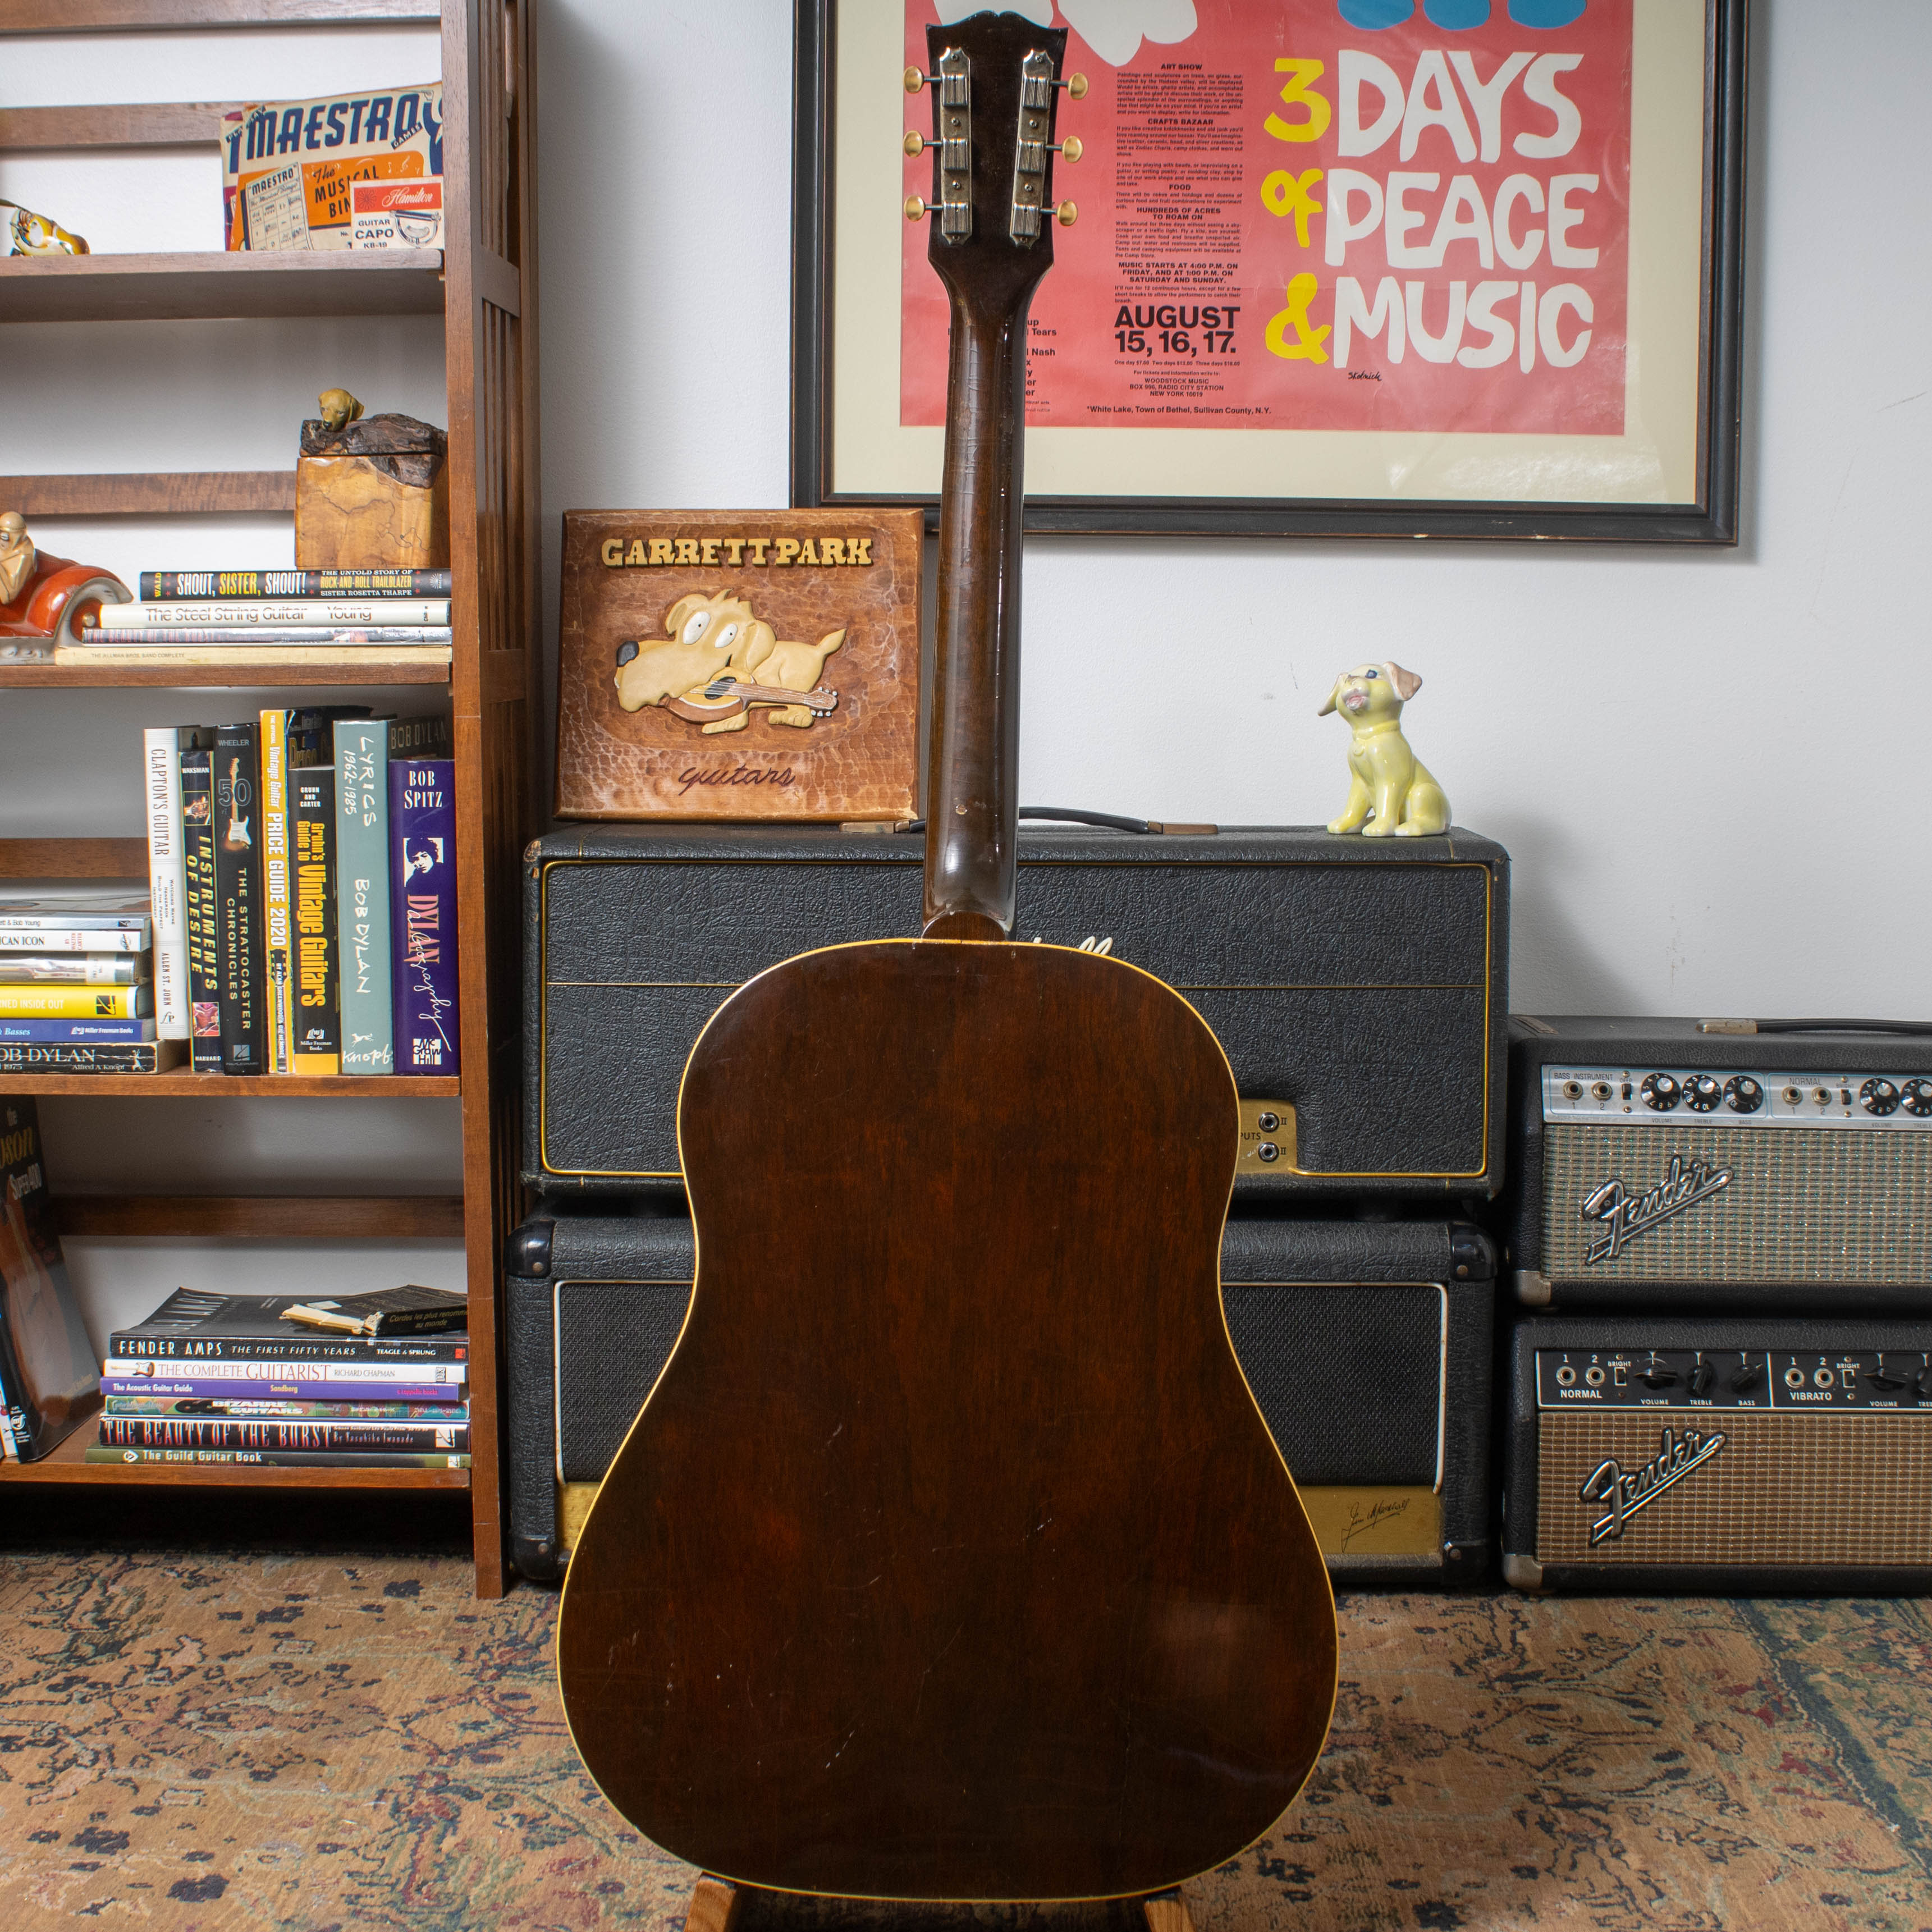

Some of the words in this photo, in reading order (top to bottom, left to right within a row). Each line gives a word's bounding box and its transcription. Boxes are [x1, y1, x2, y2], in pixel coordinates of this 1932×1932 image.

[1263, 58, 1331, 142] 3
[1338, 49, 1585, 163] DAYS
[246, 93, 420, 161] MAESTRO
[251, 168, 295, 196] MAESTRO
[313, 165, 335, 184] The
[382, 187, 434, 207] Hamilton
[1261, 168, 1324, 248] of
[1325, 168, 1599, 269] PEACE
[355, 228, 393, 239] CAPO
[1114, 305, 1240, 329] AUGUST
[1265, 272, 1331, 364] &
[1333, 276, 1594, 374] MUSIC
[1115, 330, 1152, 358] 15,
[1159, 331, 1197, 358] 16,
[1203, 331, 1236, 353] 17.
[177, 573, 215, 597] SHOUT,
[219, 573, 261, 597] SISTER,
[265, 572, 306, 594] SHOUT!
[320, 576, 370, 589] ROCK-AND-ROLL
[372, 575, 412, 588] TRAILBLAZER
[146, 608, 171, 621] The
[175, 607, 211, 621] Steel
[214, 607, 259, 622] String
[263, 607, 308, 620] Guitar
[327, 606, 372, 621] Young
[391, 725, 411, 749] BOB
[414, 720, 446, 745] DYLAN
[267, 746, 280, 779] Vintage
[151, 749, 168, 809] CLAPTON'S
[217, 778, 252, 807] 50
[344, 750, 357, 815] 1962-1985
[359, 736, 377, 826] LYRICS
[409, 771, 435, 786] BOB
[269, 781, 281, 808] Guitar
[153, 815, 170, 855] GUITAR
[267, 813, 284, 855] PRICE
[296, 821, 311, 848] Guide
[311, 823, 325, 861] Gruhn's
[186, 855, 198, 882] OF
[297, 851, 310, 861] to
[238, 868, 248, 897] THE
[268, 859, 286, 903] GUIDE
[297, 864, 327, 933] Vintage
[355, 879, 369, 918] BOB
[198, 836, 218, 991] INSTRUMENTS
[269, 907, 286, 946] 2020
[22, 936, 45, 945] ICON
[187, 891, 203, 973] DESIRE
[404, 894, 440, 964] DYLAN
[162, 953, 170, 972] ALLEN
[227, 898, 237, 1000] CHRONICLES
[351, 924, 371, 993] DYLAN
[239, 906, 250, 1029] STRATOCASTER
[299, 937, 328, 1006] Guitars
[20, 1000, 46, 1009] INSIDE
[48, 1000, 64, 1009] OUT
[28, 1049, 95, 1062] DYLAN
[342, 1044, 392, 1065] Knopf
[1554, 1072, 1570, 1080] BASS
[1573, 1073, 1613, 1082] INSTRUMENT
[1789, 1077, 1823, 1087] NORMAL
[1581, 1153, 1734, 1266] Fender
[120, 1341, 175, 1354] FENDER
[185, 1342, 222, 1356] AMPS
[158, 1364, 181, 1376] THE
[184, 1364, 243, 1377] COMPLETE
[246, 1363, 332, 1380] GUITARIST
[113, 1383, 125, 1391] The
[126, 1383, 152, 1392] Acoustic
[153, 1383, 172, 1392] Guitar
[174, 1383, 193, 1393] Guide
[270, 1385, 298, 1394] Sandberg
[1560, 1389, 1603, 1399] NORMAL
[1789, 1391, 1832, 1402] VIBRATO
[104, 1421, 136, 1447] THE
[143, 1421, 204, 1447] BEAUTY
[212, 1422, 230, 1447] OF
[239, 1422, 270, 1448] THE
[279, 1423, 332, 1448] BURST
[143, 1451, 162, 1459] The
[166, 1451, 193, 1460] Guild
[196, 1452, 231, 1461] Guitar
[235, 1452, 262, 1461] Book
[1580, 1427, 1727, 1548] Fender
